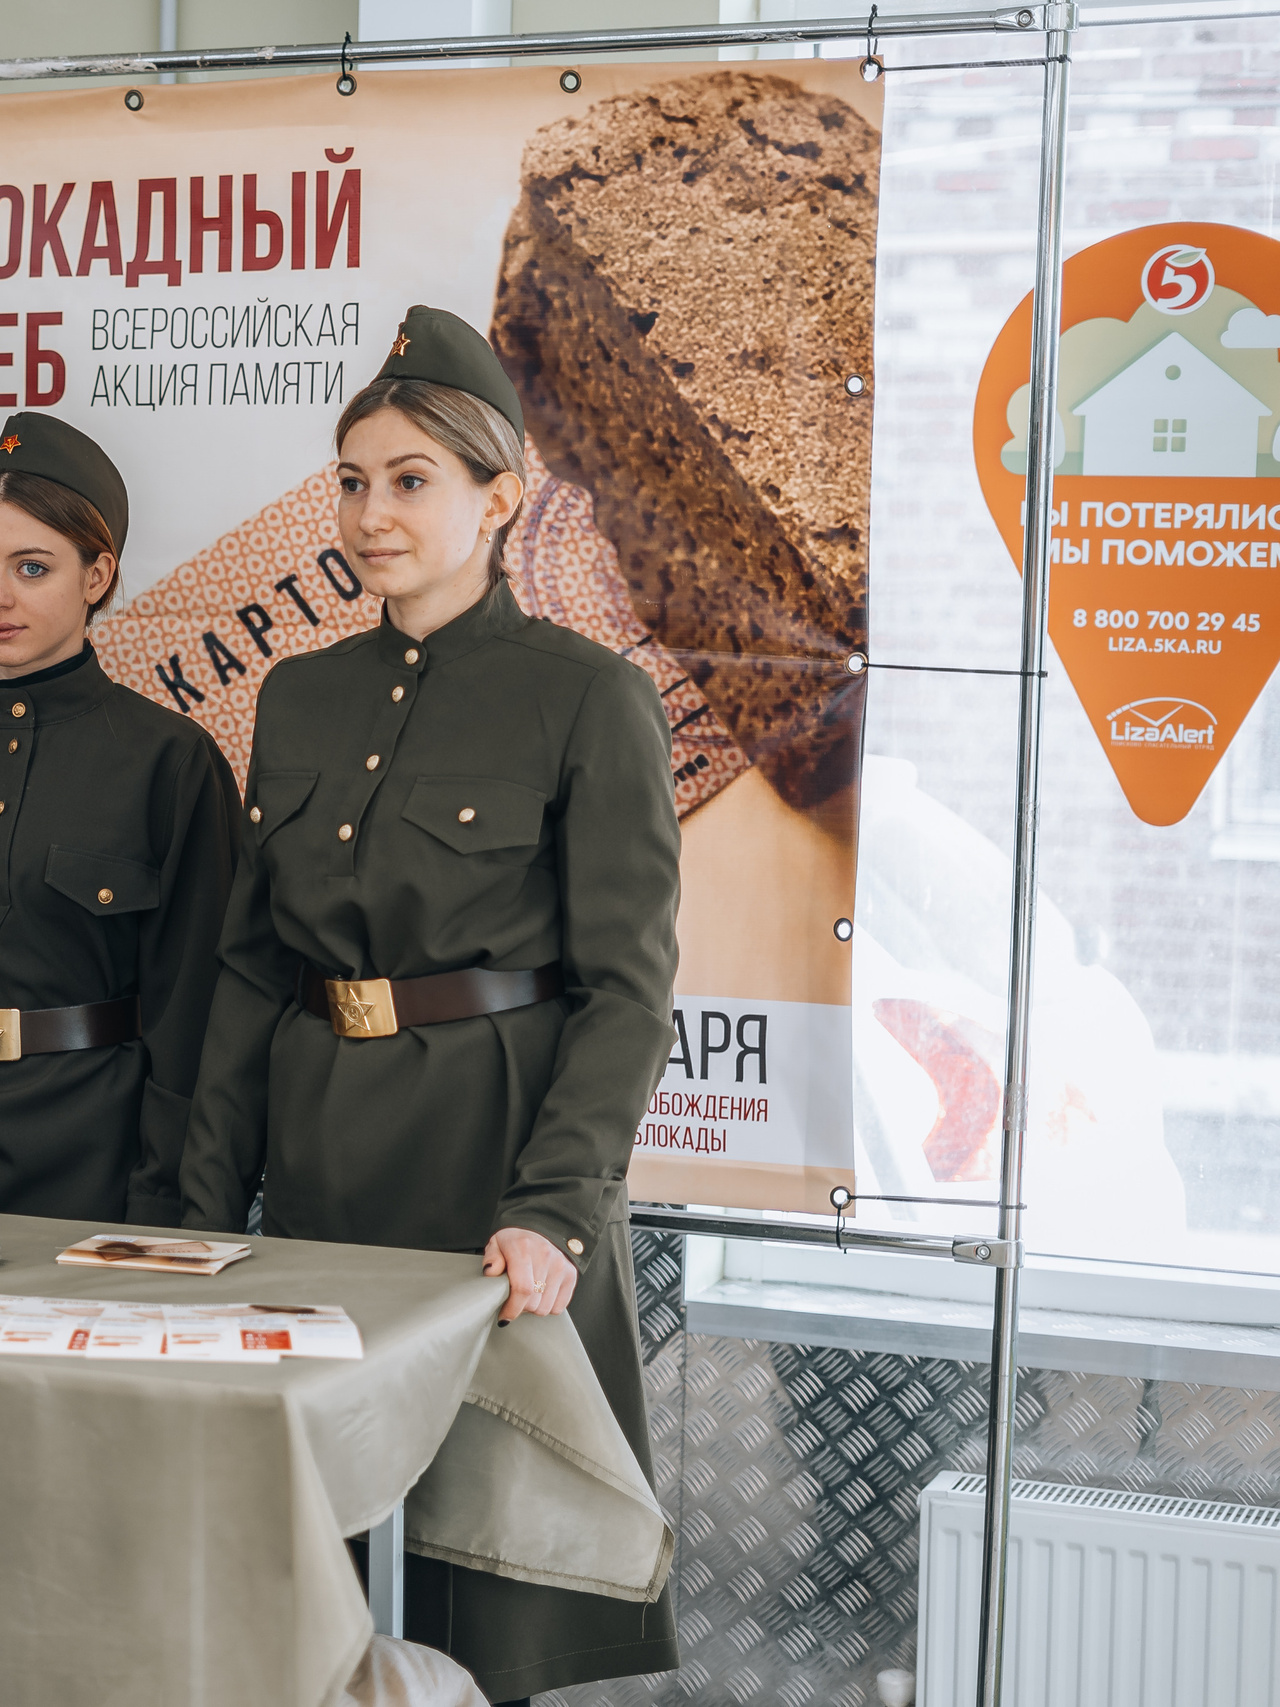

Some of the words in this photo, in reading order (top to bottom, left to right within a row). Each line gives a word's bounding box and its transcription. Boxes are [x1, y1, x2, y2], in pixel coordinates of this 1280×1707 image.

[91, 297, 361, 351] ВСЕРОССИЙСКАЯ
[90, 363, 198, 411] АКЦИЯ
[208, 360, 345, 407] ПАМЯТИ
[1020, 501, 1069, 528] Ы
[1073, 608, 1087, 628] 8
[1094, 609, 1139, 629] 800
[1147, 611, 1190, 631] 700
[1196, 612, 1225, 632] 29
[1232, 613, 1261, 633] 45
[1108, 637, 1222, 654] LIZA.5KA.RU
[1111, 721, 1215, 744] LizaAlert
